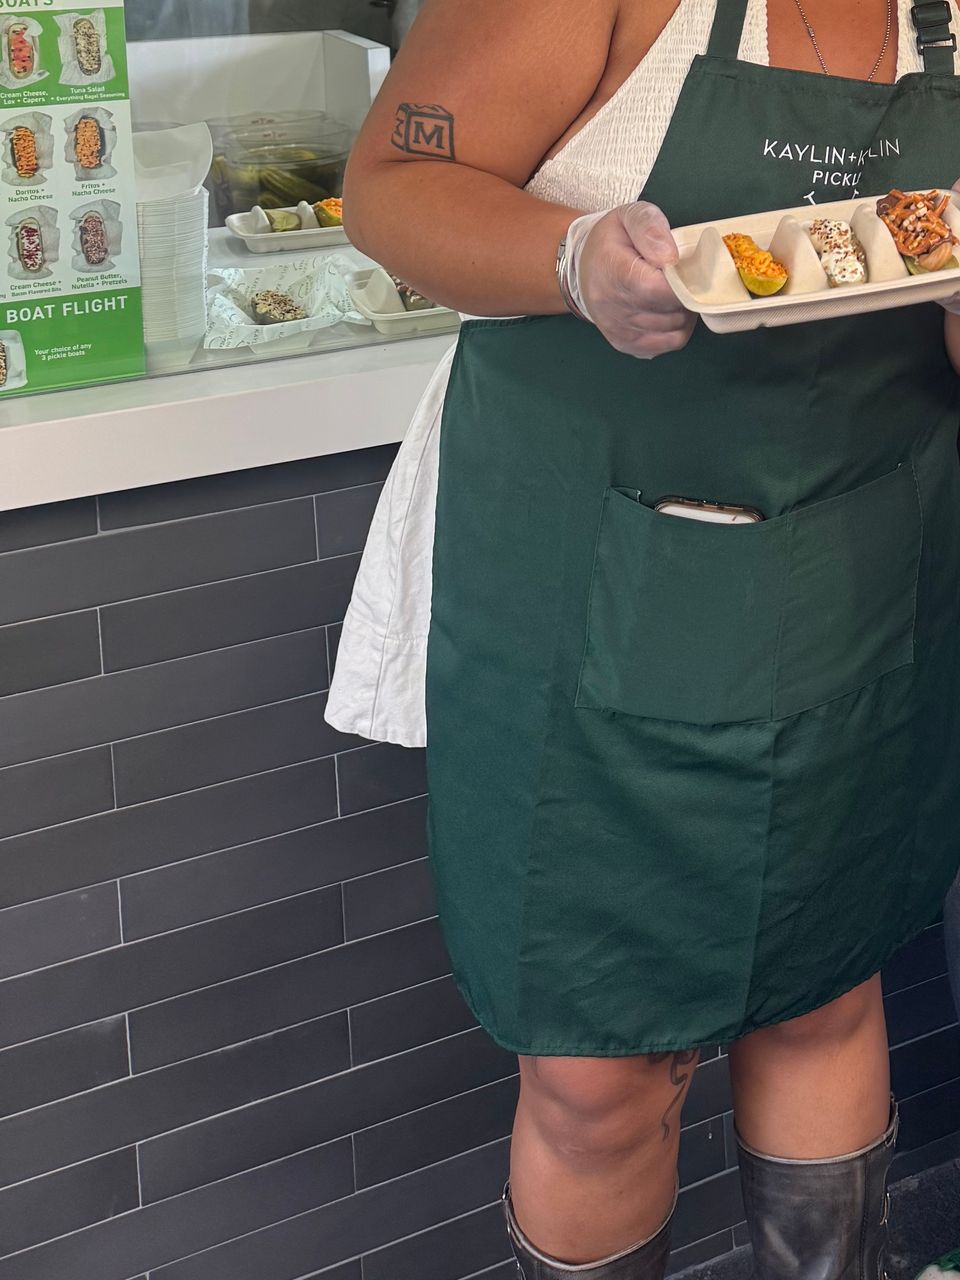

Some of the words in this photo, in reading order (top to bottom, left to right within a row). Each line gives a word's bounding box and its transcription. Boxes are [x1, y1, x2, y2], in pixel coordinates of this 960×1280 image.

[413, 121, 445, 149] M
[77, 275, 98, 283] Peanut
[7, 305, 55, 323] BOAT
[62, 296, 128, 316] FLIGHT
[51, 345, 71, 353] choice
[47, 352, 67, 361] pickle
